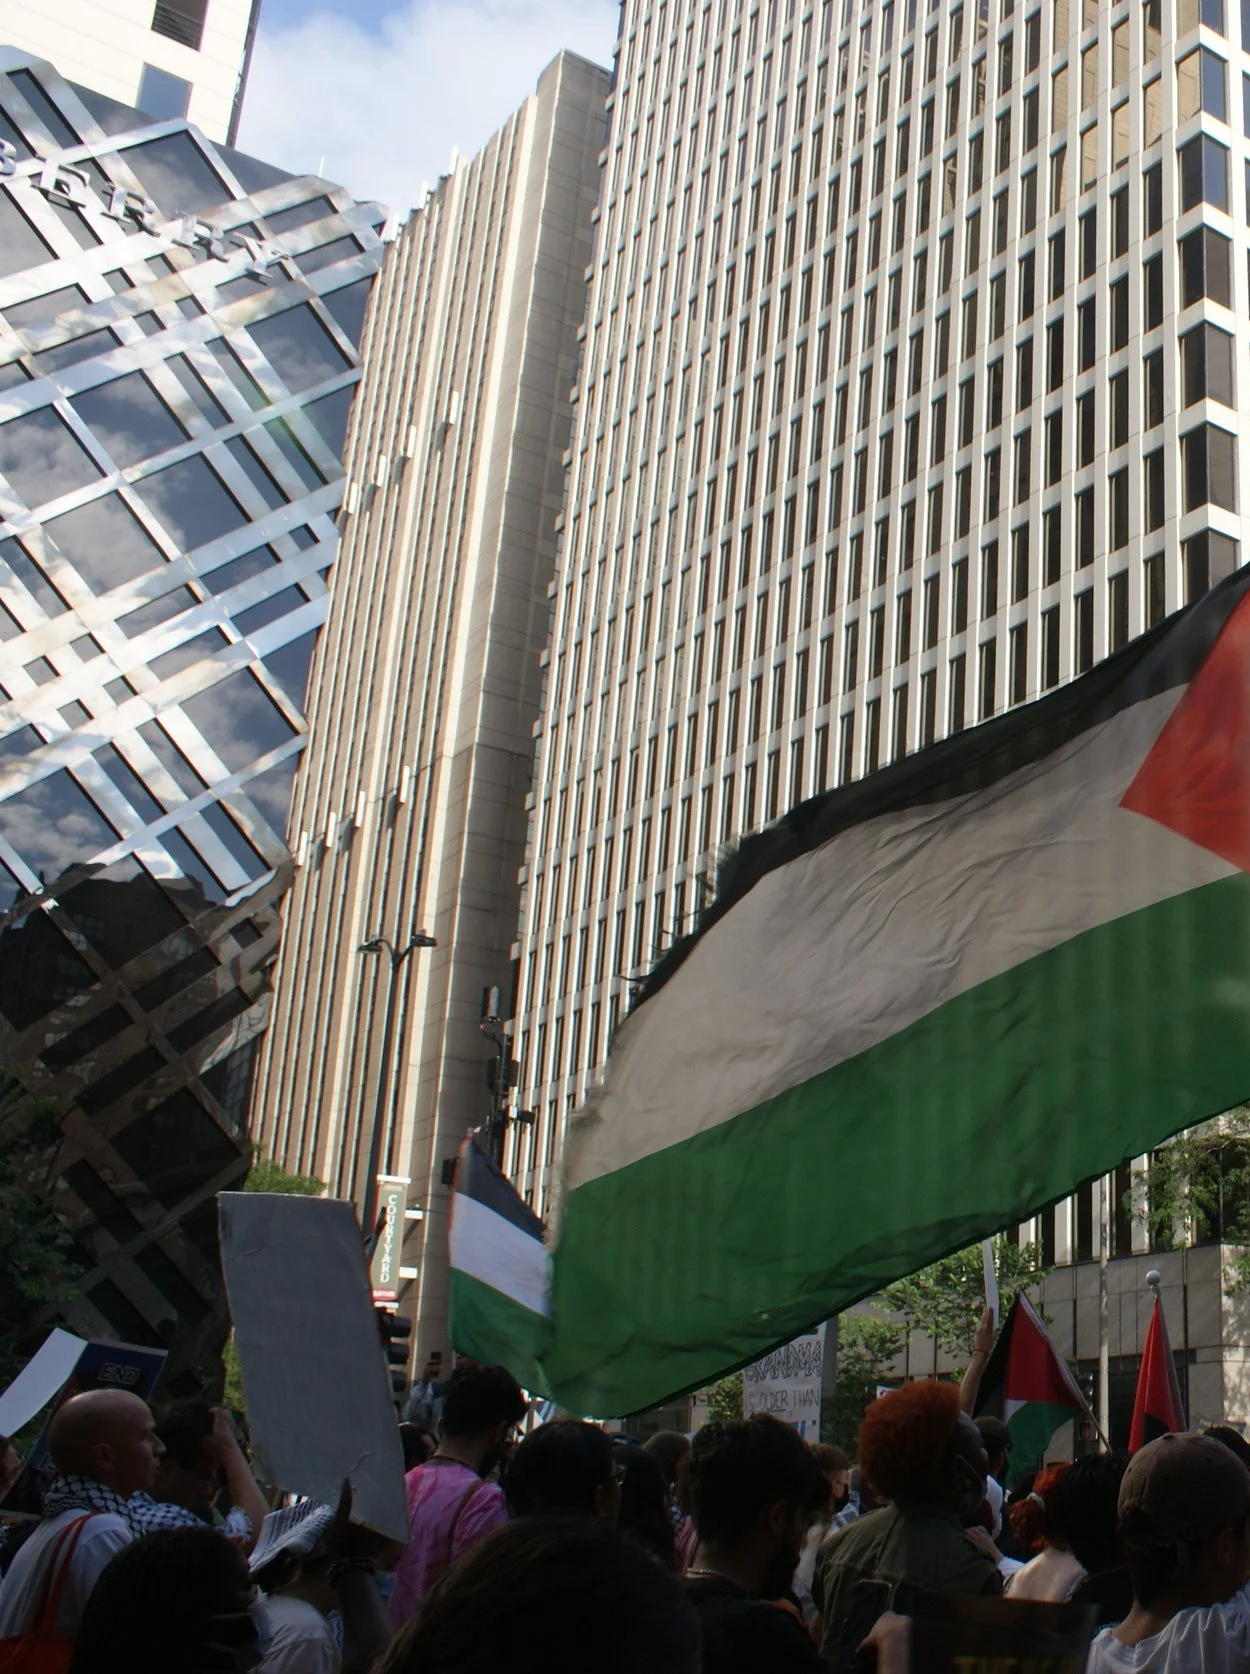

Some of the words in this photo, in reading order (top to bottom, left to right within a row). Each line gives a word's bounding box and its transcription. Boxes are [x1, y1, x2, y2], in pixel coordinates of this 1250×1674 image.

[380, 1194, 398, 1283] COURTYARD
[97, 1362, 140, 1386] END
[761, 1390, 790, 1409] OLDER
[792, 1388, 820, 1407] THAN
